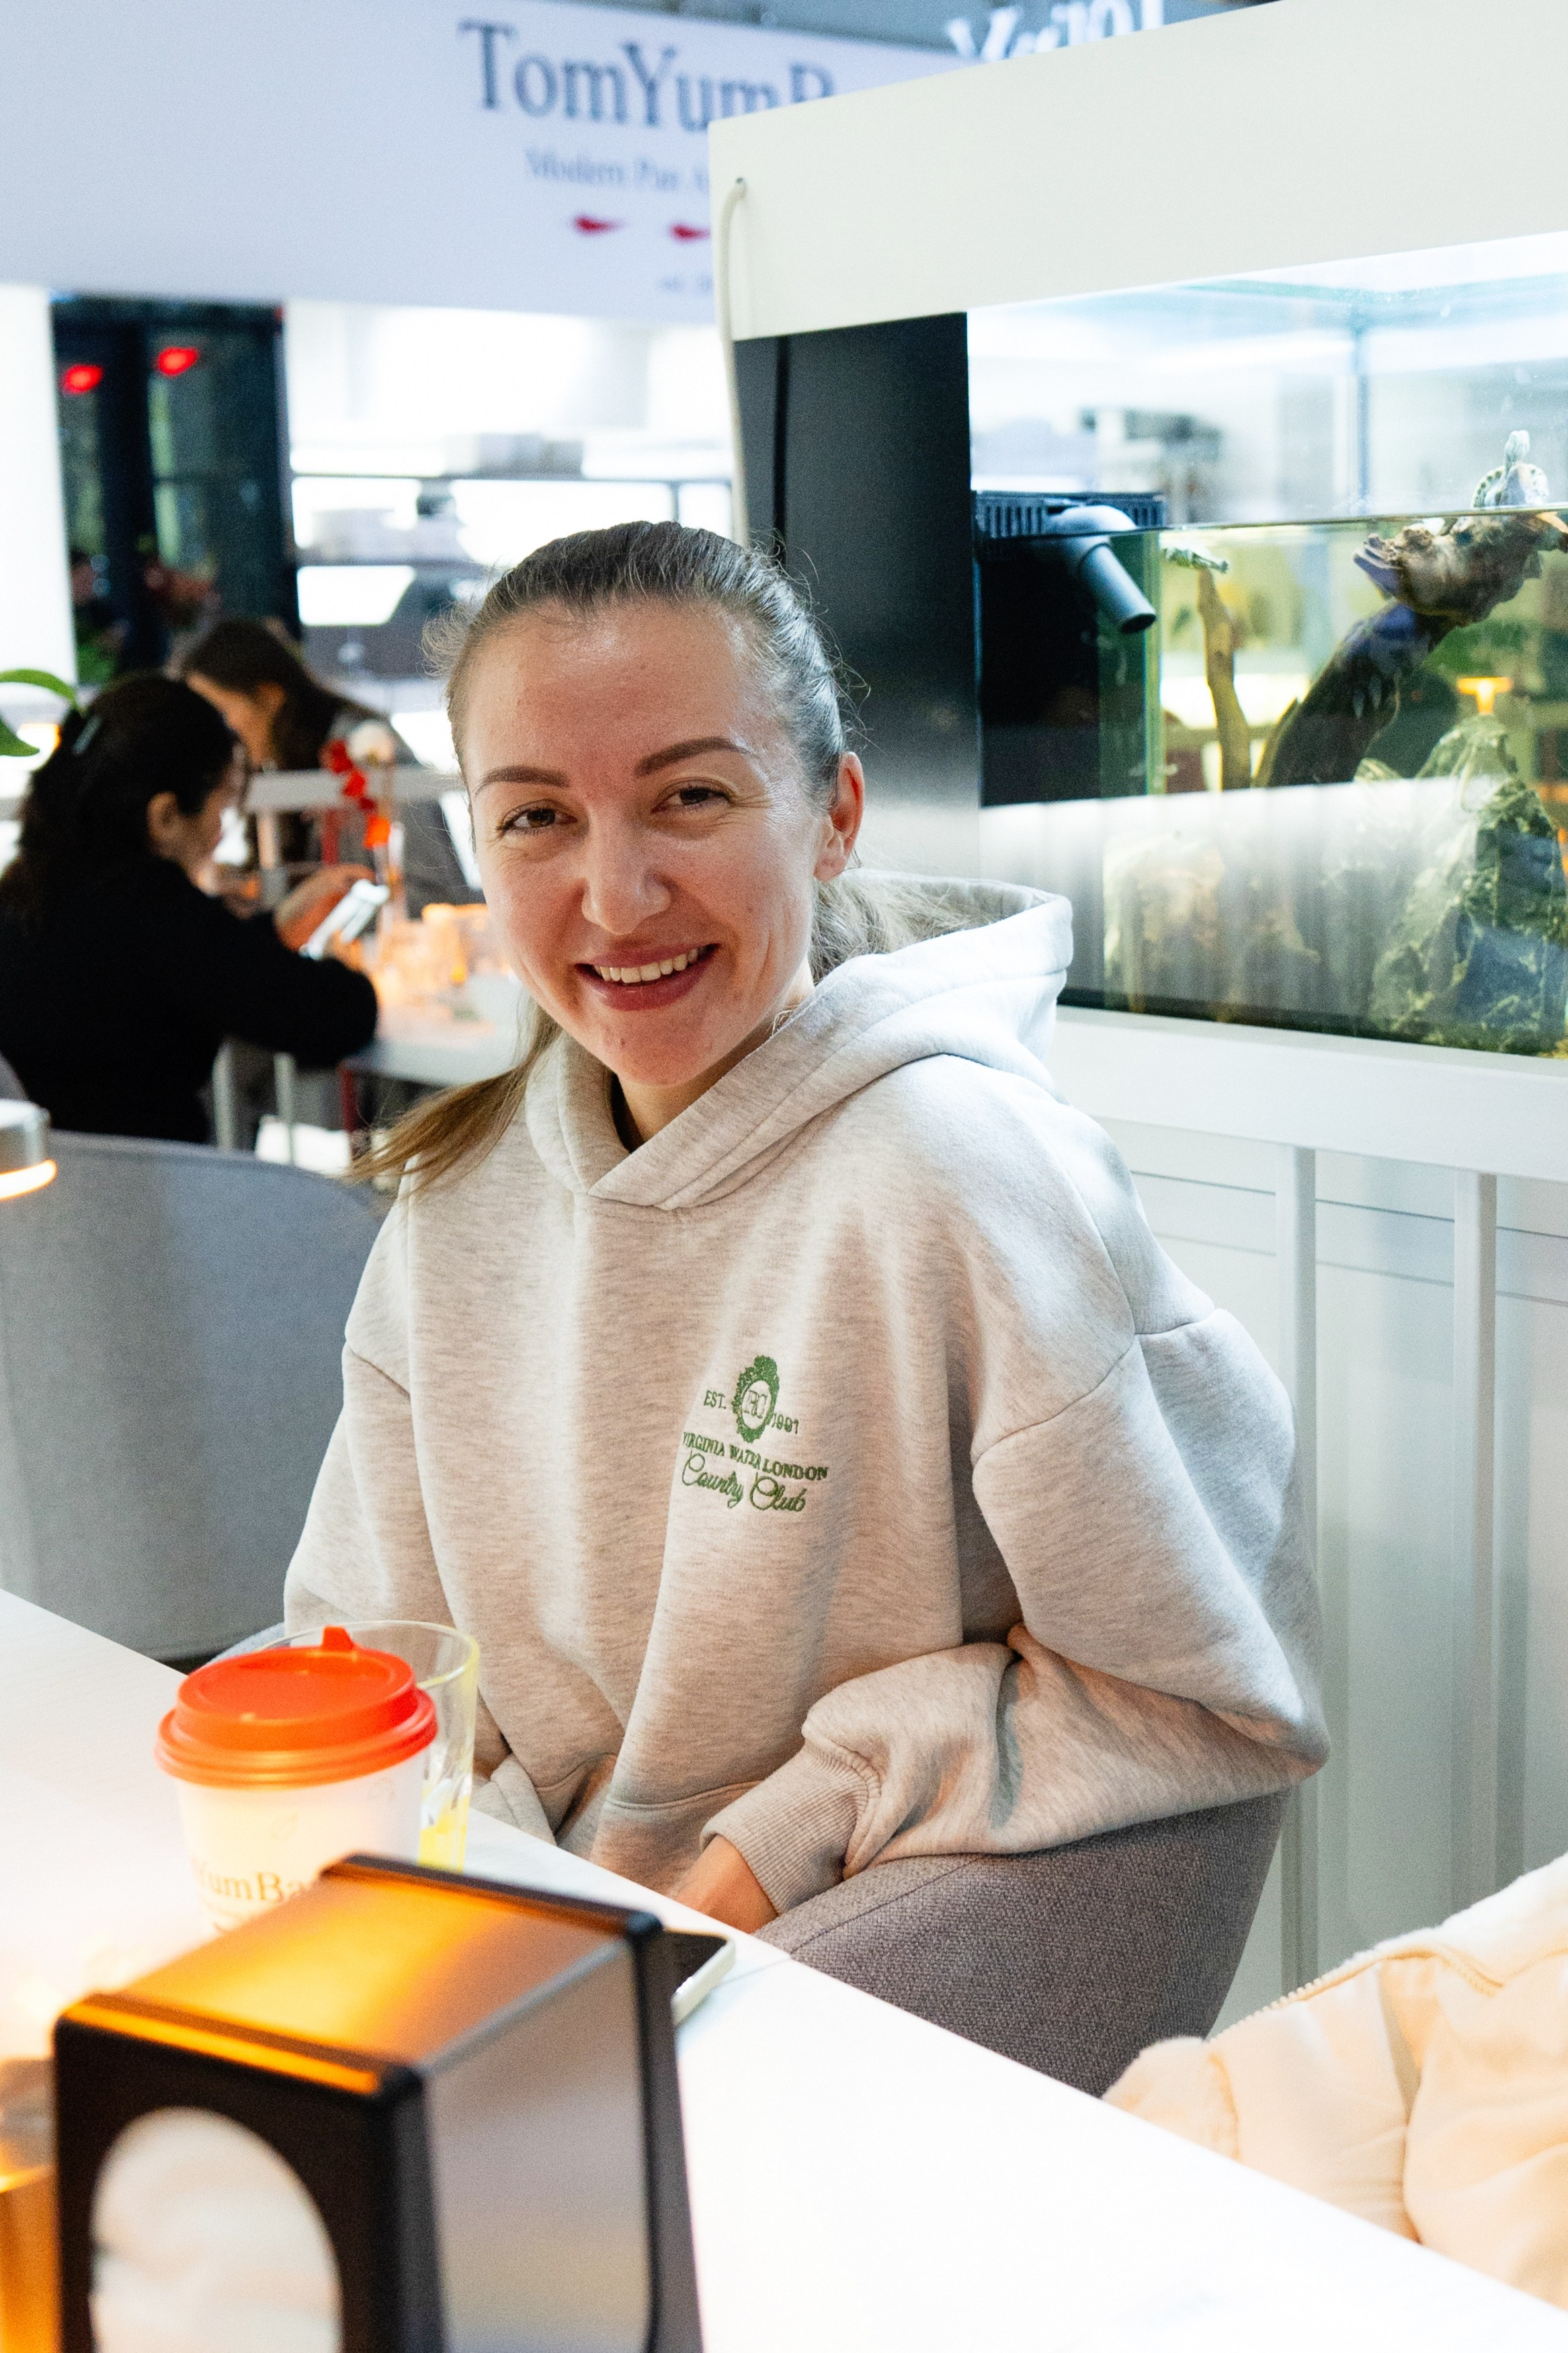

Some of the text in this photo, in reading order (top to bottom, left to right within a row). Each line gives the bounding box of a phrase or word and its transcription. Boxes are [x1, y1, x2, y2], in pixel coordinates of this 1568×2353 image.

[704, 1389, 727, 1410] EST.
[682, 1449, 808, 1512] Country Club
[683, 1431, 725, 1457] VIRGINIA
[761, 1458, 829, 1481] LONDON
